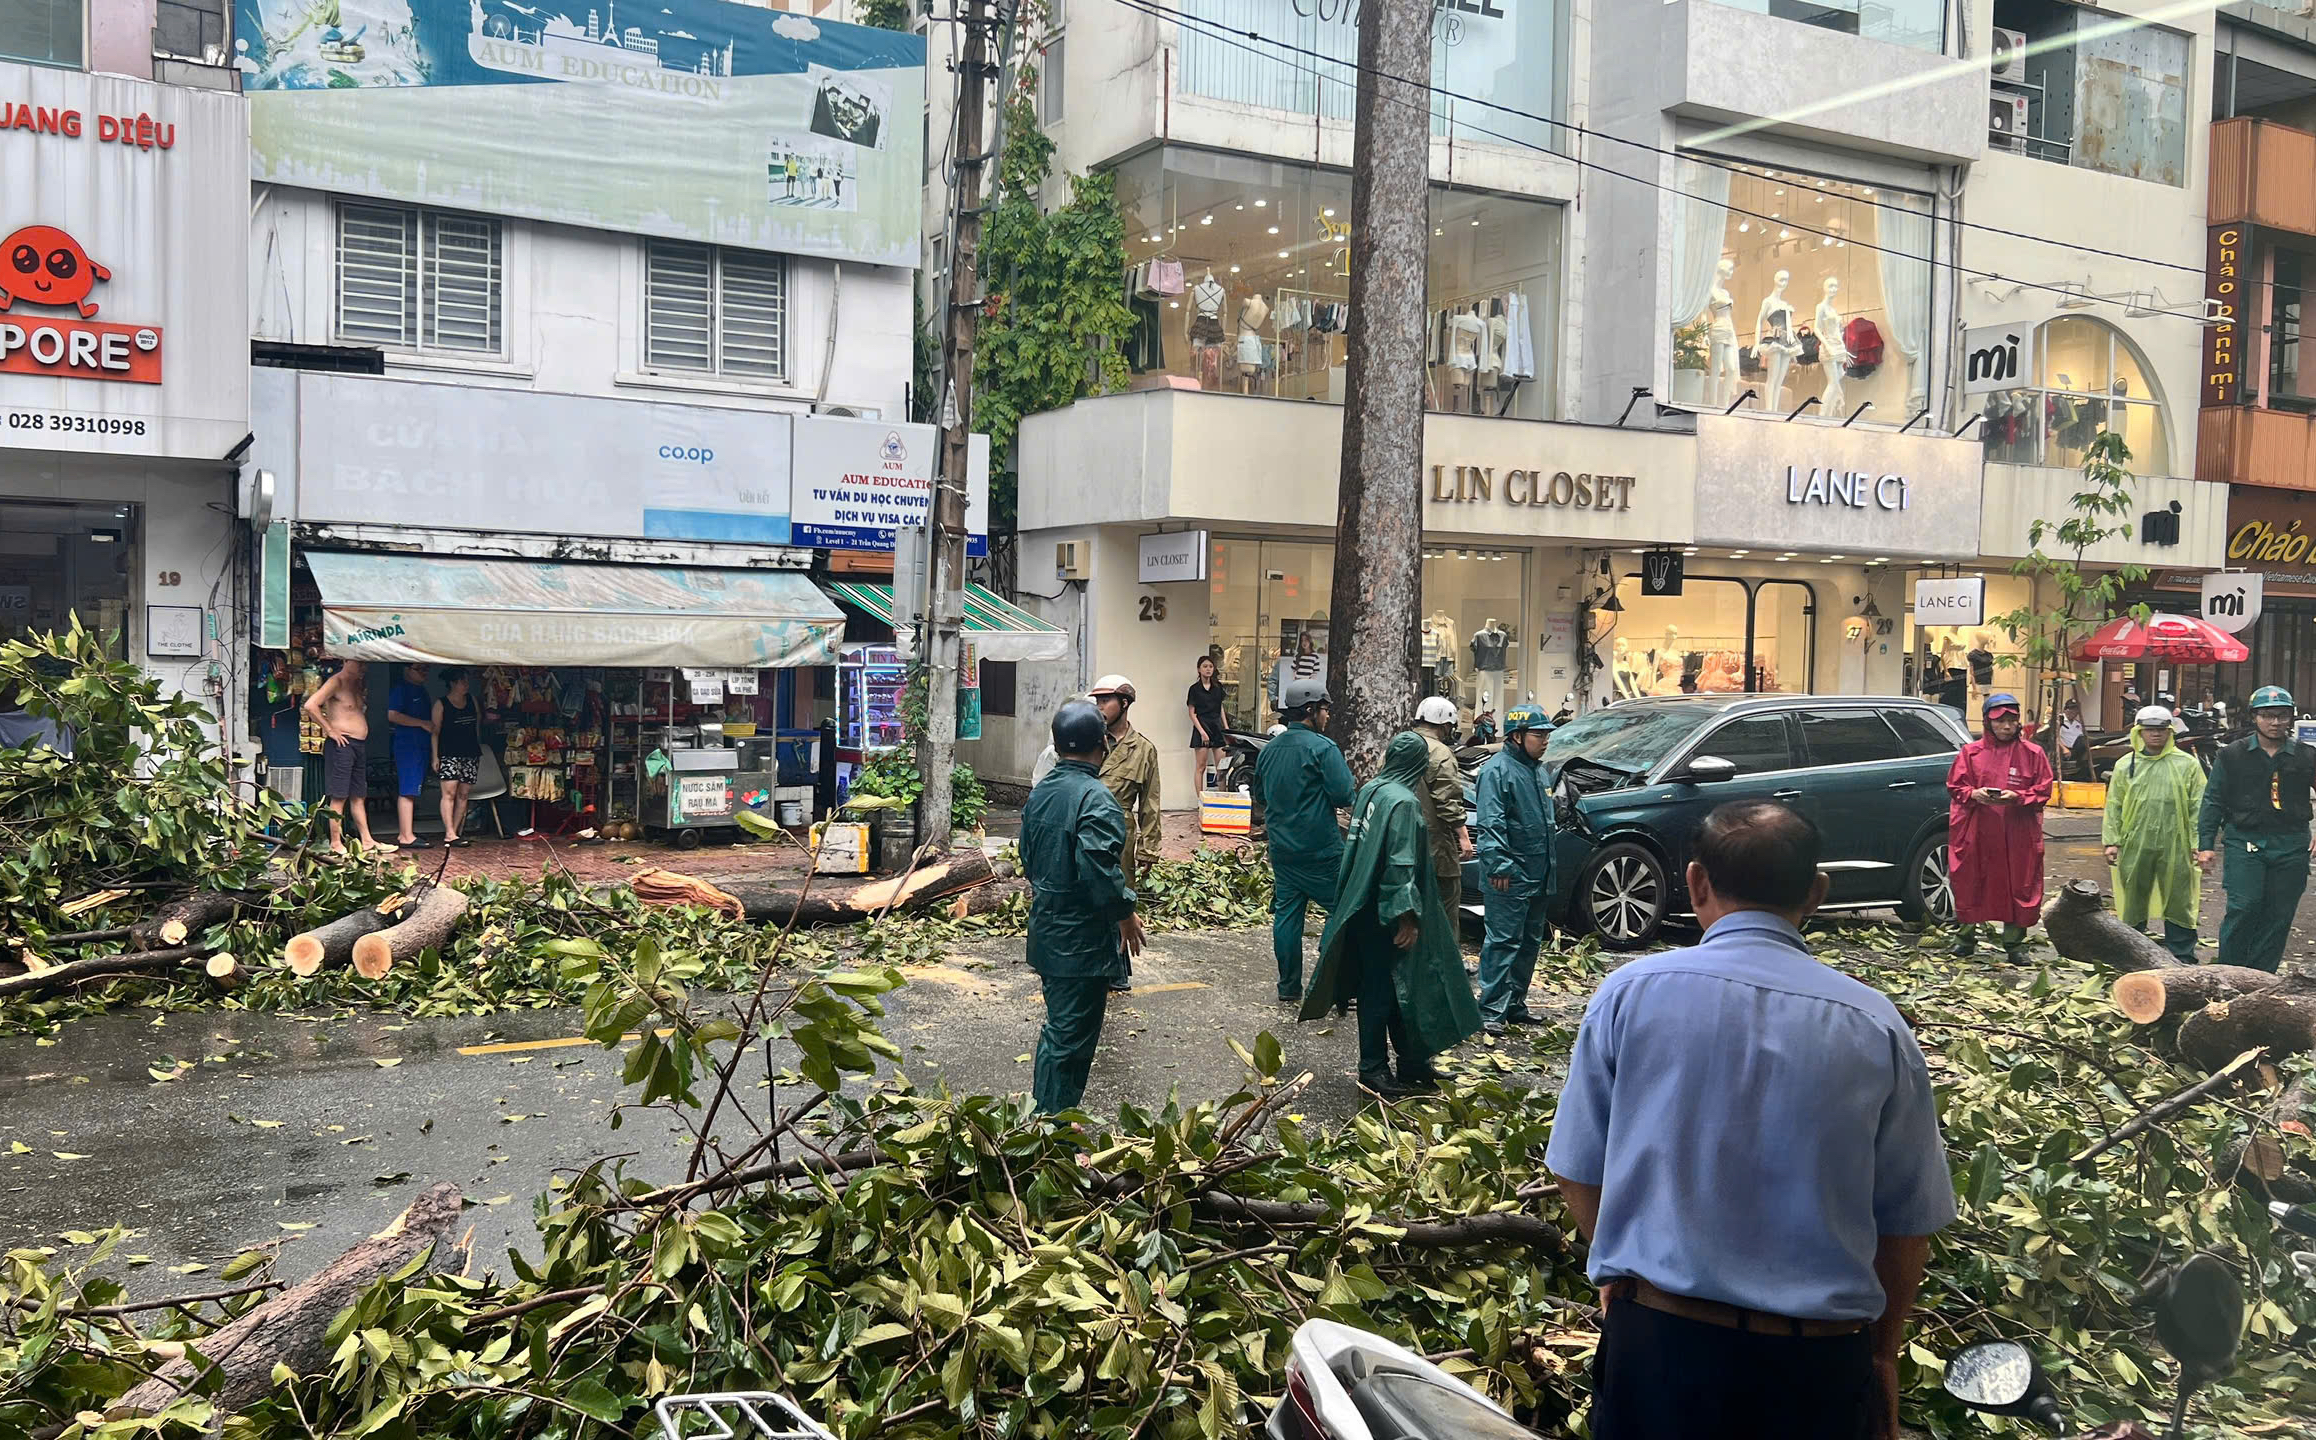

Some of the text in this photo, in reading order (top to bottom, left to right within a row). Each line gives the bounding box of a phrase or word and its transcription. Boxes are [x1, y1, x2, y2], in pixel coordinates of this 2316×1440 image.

[479, 41, 721, 100] AUM EDUCATION
[98, 112, 175, 152] DIỆU
[0, 323, 131, 370] PORE
[1968, 333, 2020, 382] mì
[9, 413, 146, 436] 028 39310998
[659, 446, 714, 464] co.op
[882, 462, 903, 471] AUM
[841, 473, 870, 485] AUM
[1432, 464, 1636, 511] LIN CLOSET
[1786, 466, 1869, 508] LANE
[853, 492, 868, 503] DU
[871, 494, 891, 507] HỌC
[835, 510, 920, 526] DỊCH VỤ VISA CÁC
[2228, 519, 2309, 563] Chảo
[1147, 553, 1189, 567] LIN CLOSET
[158, 571, 182, 586] 19
[2263, 570, 2302, 583] Vietnamese
[1138, 596, 1166, 621] 25
[1920, 597, 1954, 608] LANE
[2209, 586, 2246, 616] mì
[1846, 625, 1862, 640] 27
[1876, 618, 1893, 635] 29
